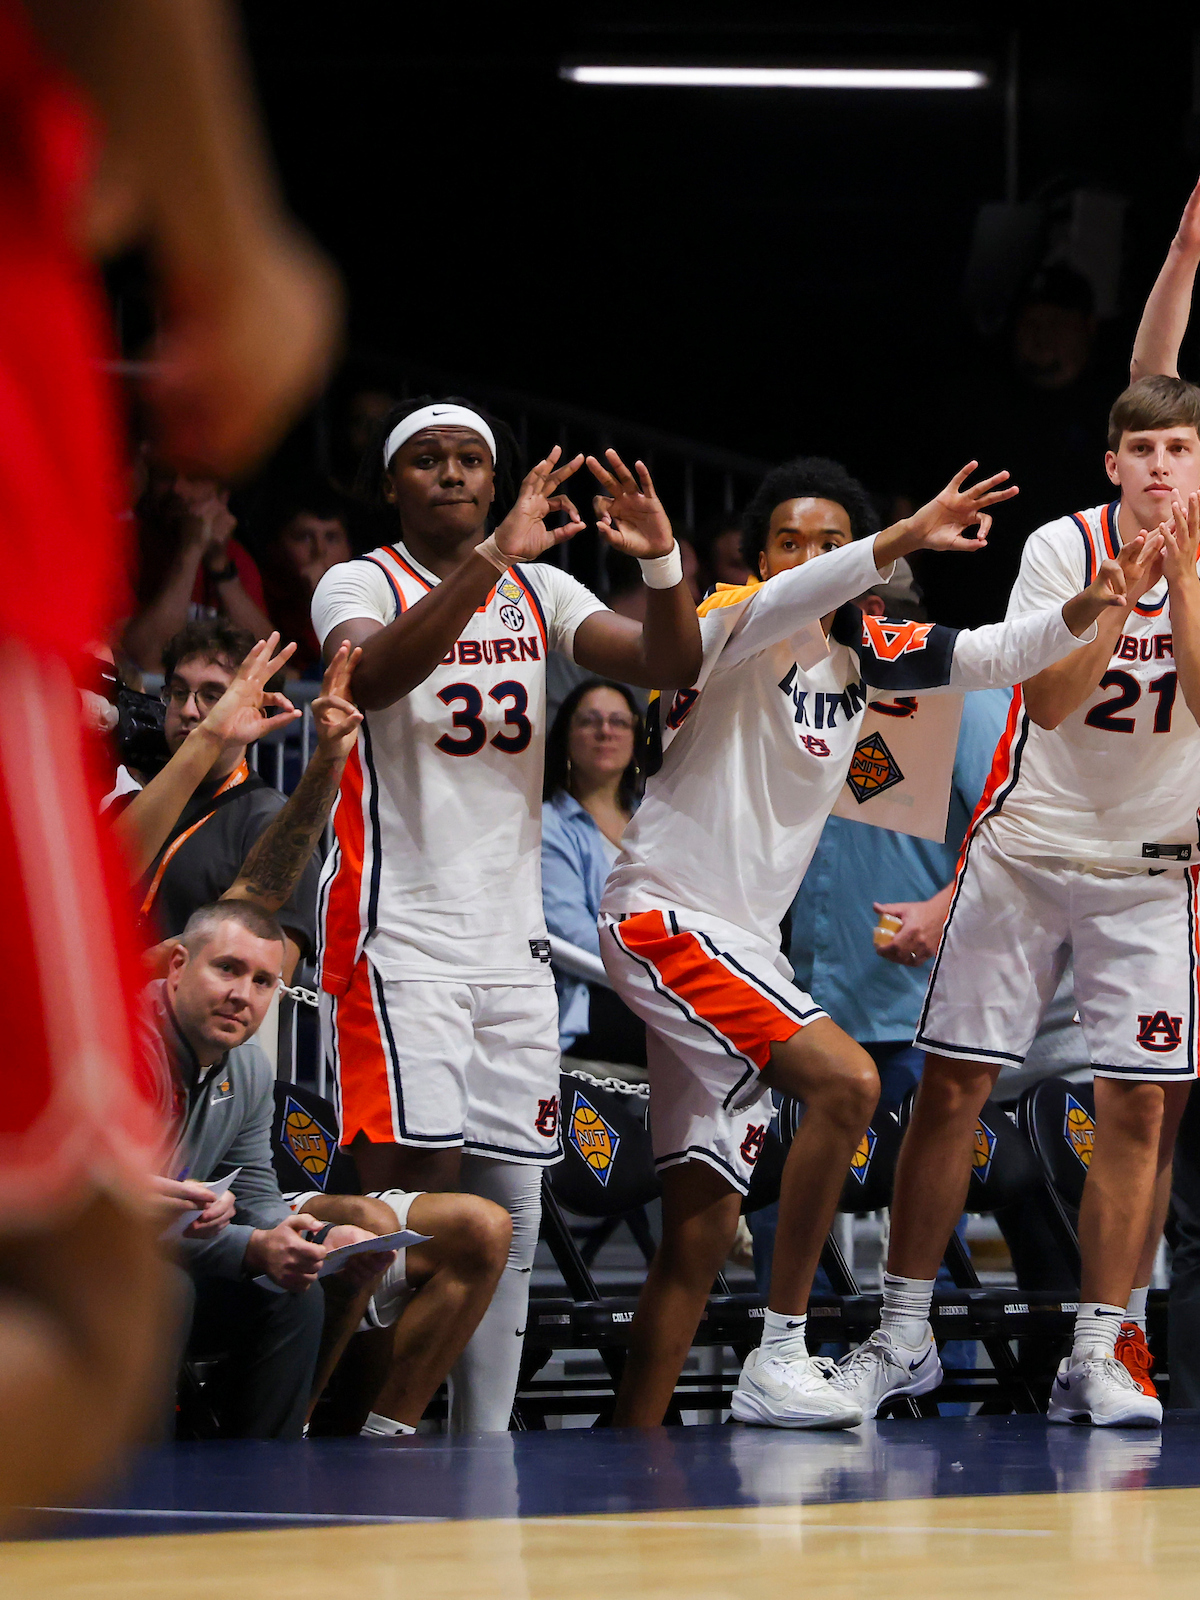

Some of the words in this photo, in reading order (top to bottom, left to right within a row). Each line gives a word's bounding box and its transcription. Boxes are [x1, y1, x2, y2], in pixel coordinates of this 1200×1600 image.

[501, 605, 524, 632] SEC
[1084, 669, 1178, 734] 21
[435, 680, 532, 757] 33
[852, 757, 889, 776] NIT
[290, 1133, 321, 1151] NIT
[577, 1129, 606, 1146] NIT
[1071, 1129, 1094, 1145] NIT
[612, 1311, 635, 1323] COLLE
